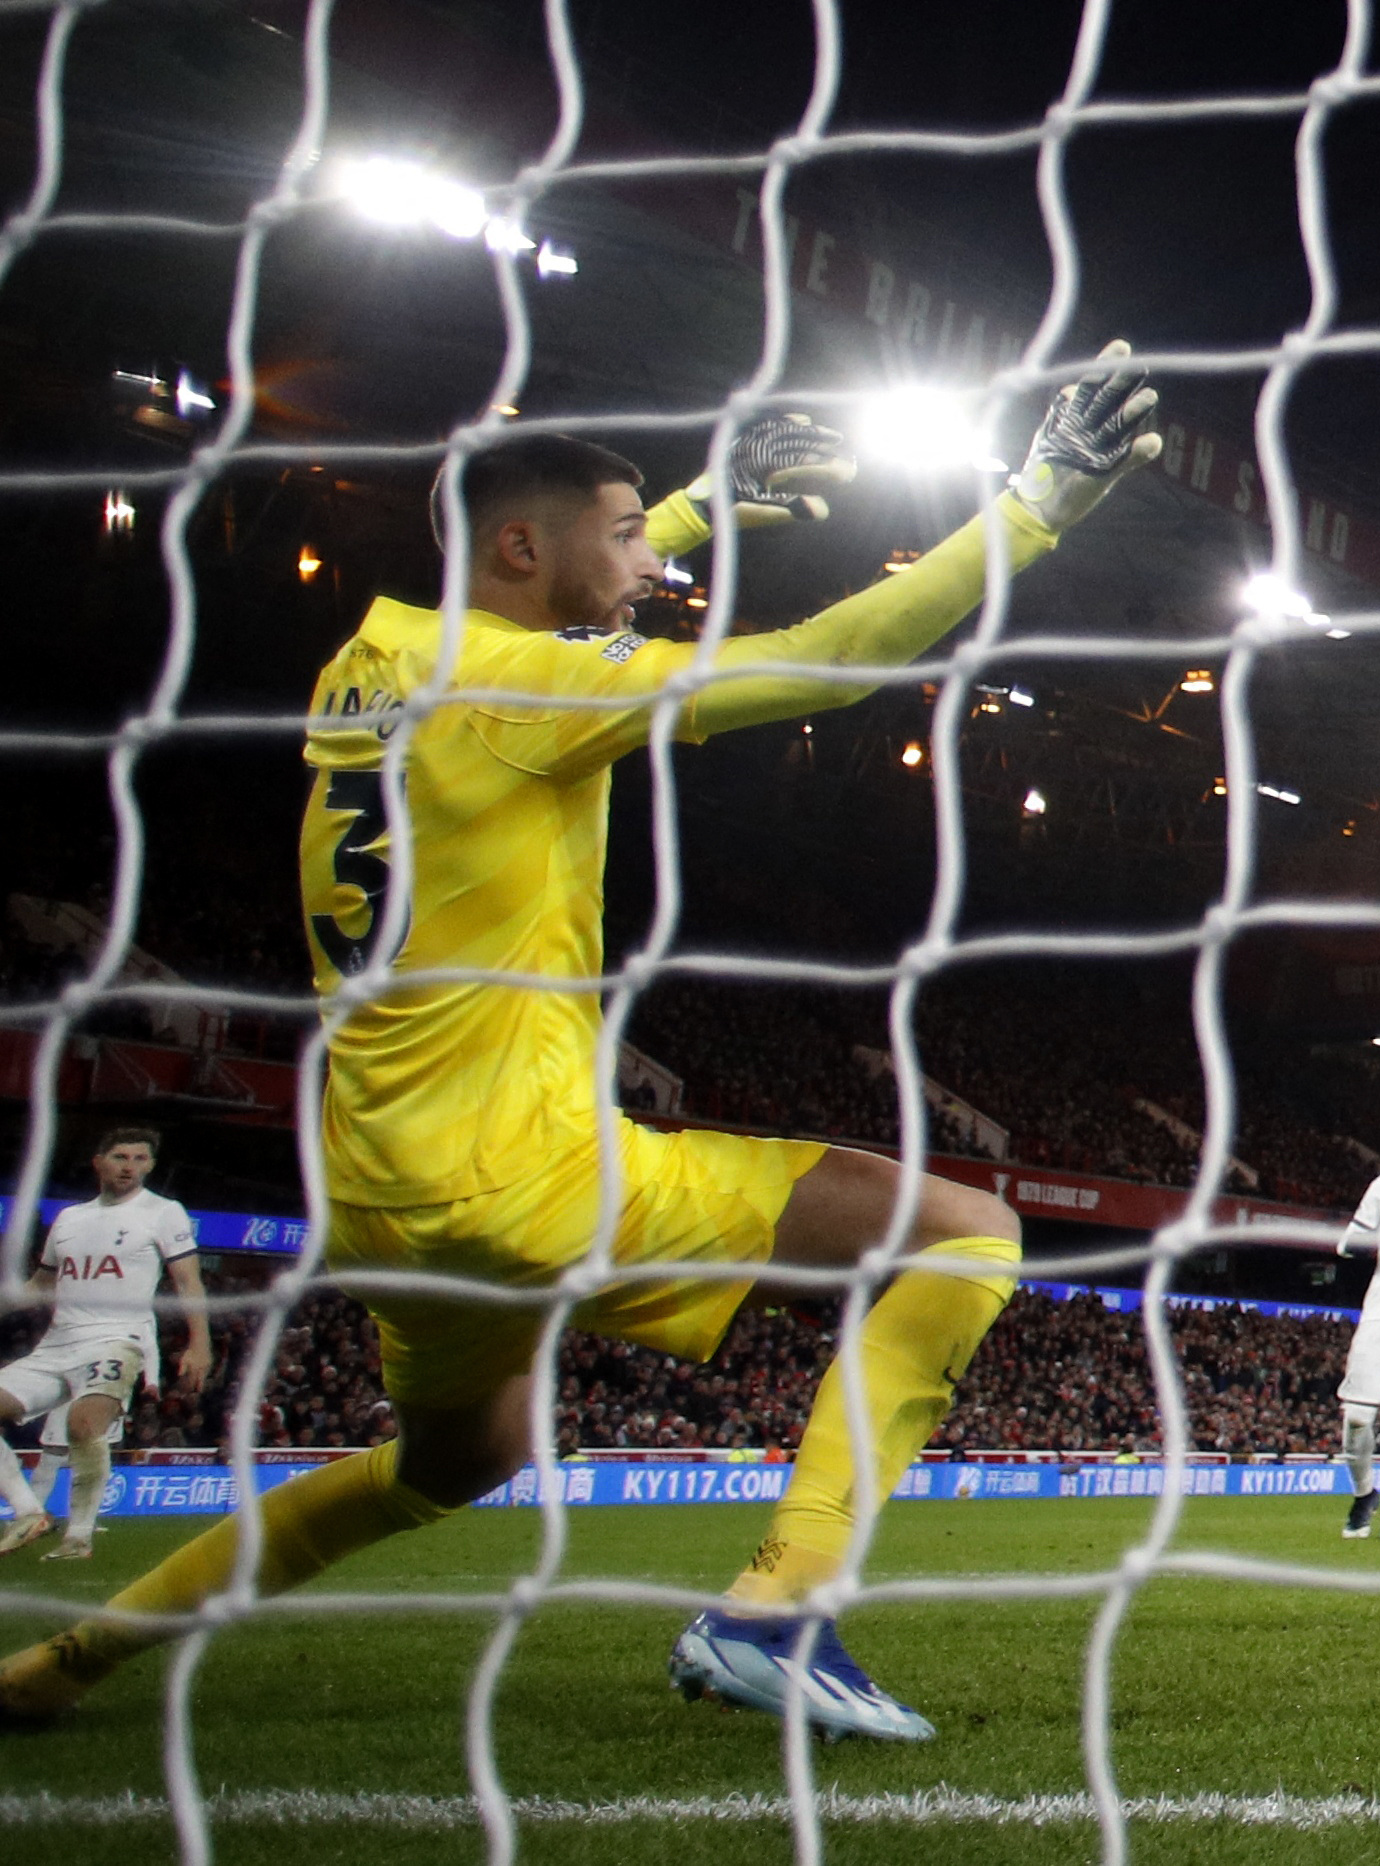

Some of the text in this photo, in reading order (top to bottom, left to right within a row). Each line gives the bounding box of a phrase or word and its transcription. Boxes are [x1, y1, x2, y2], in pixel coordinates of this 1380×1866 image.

[59, 1255, 124, 1280] AIA
[86, 1360, 124, 1381] 33
[623, 1469, 784, 1500] KY117.COM
[1241, 1469, 1335, 1492] KY117.COM
